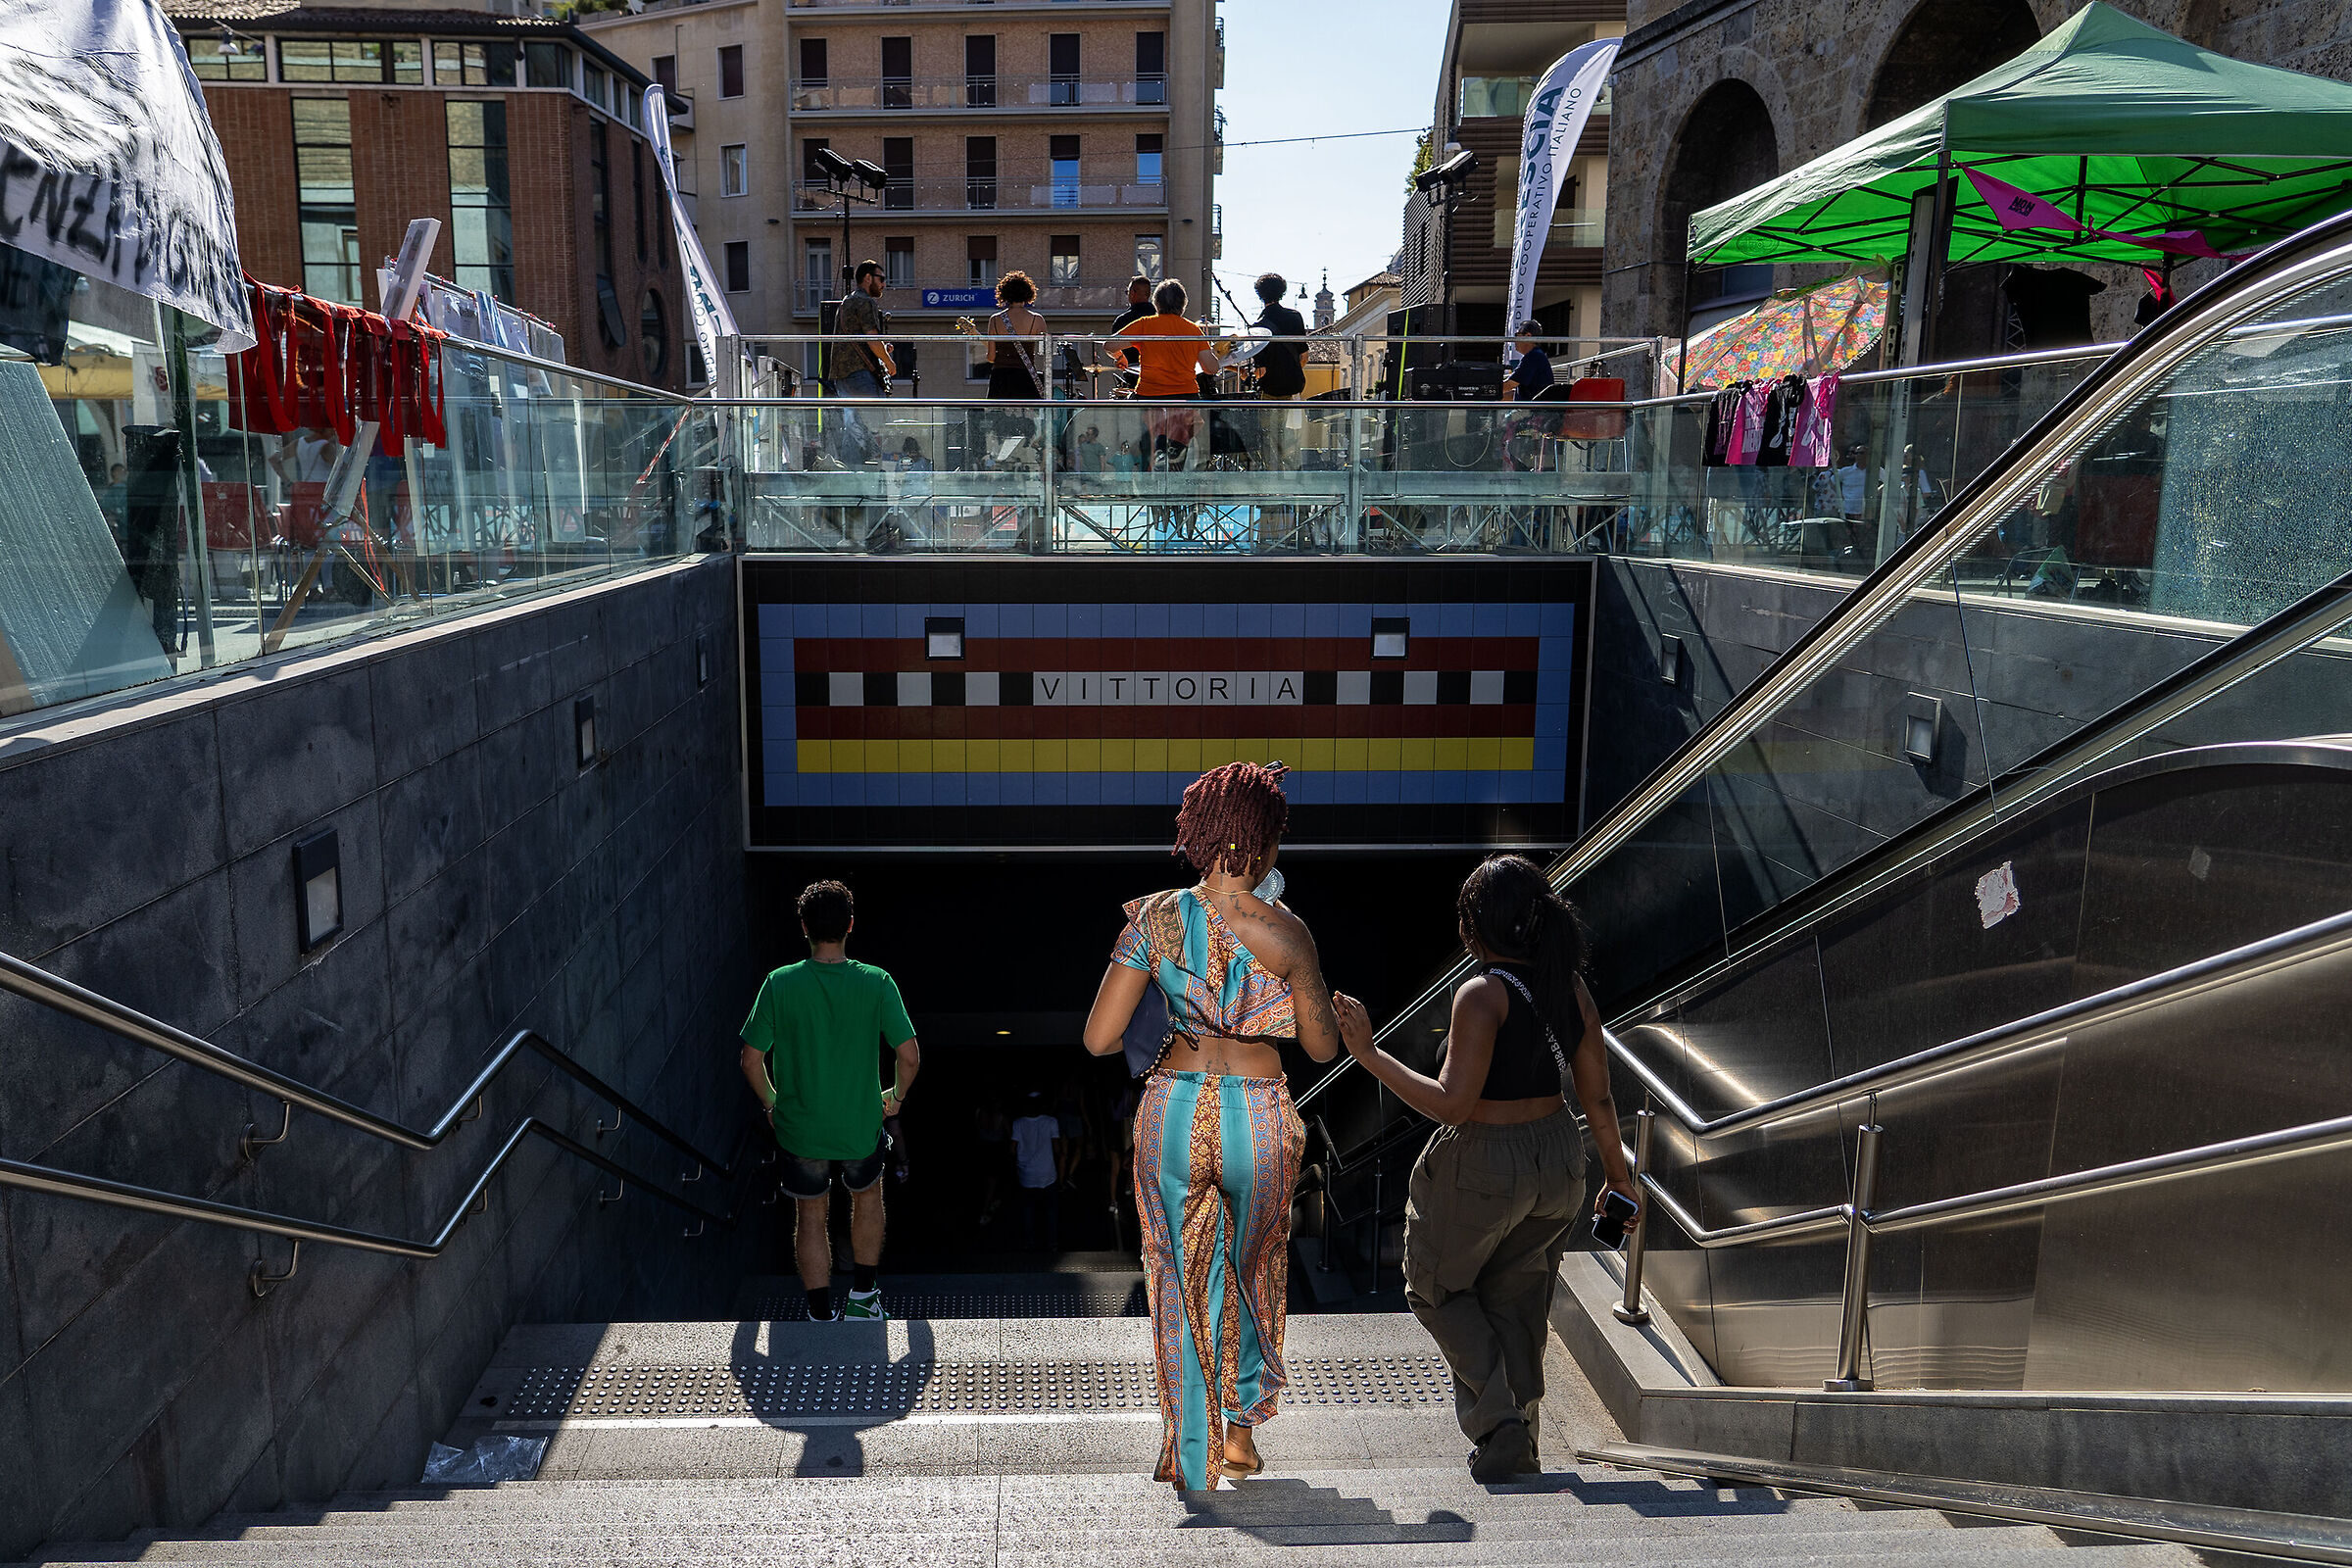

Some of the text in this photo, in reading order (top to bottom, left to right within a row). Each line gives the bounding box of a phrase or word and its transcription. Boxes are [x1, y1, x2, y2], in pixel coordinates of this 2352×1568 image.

[1520, 163, 1552, 276] COOPERATIVO
[1547, 87, 1582, 157] ITALIANO
[1041, 677, 1297, 700] VITTORIA
